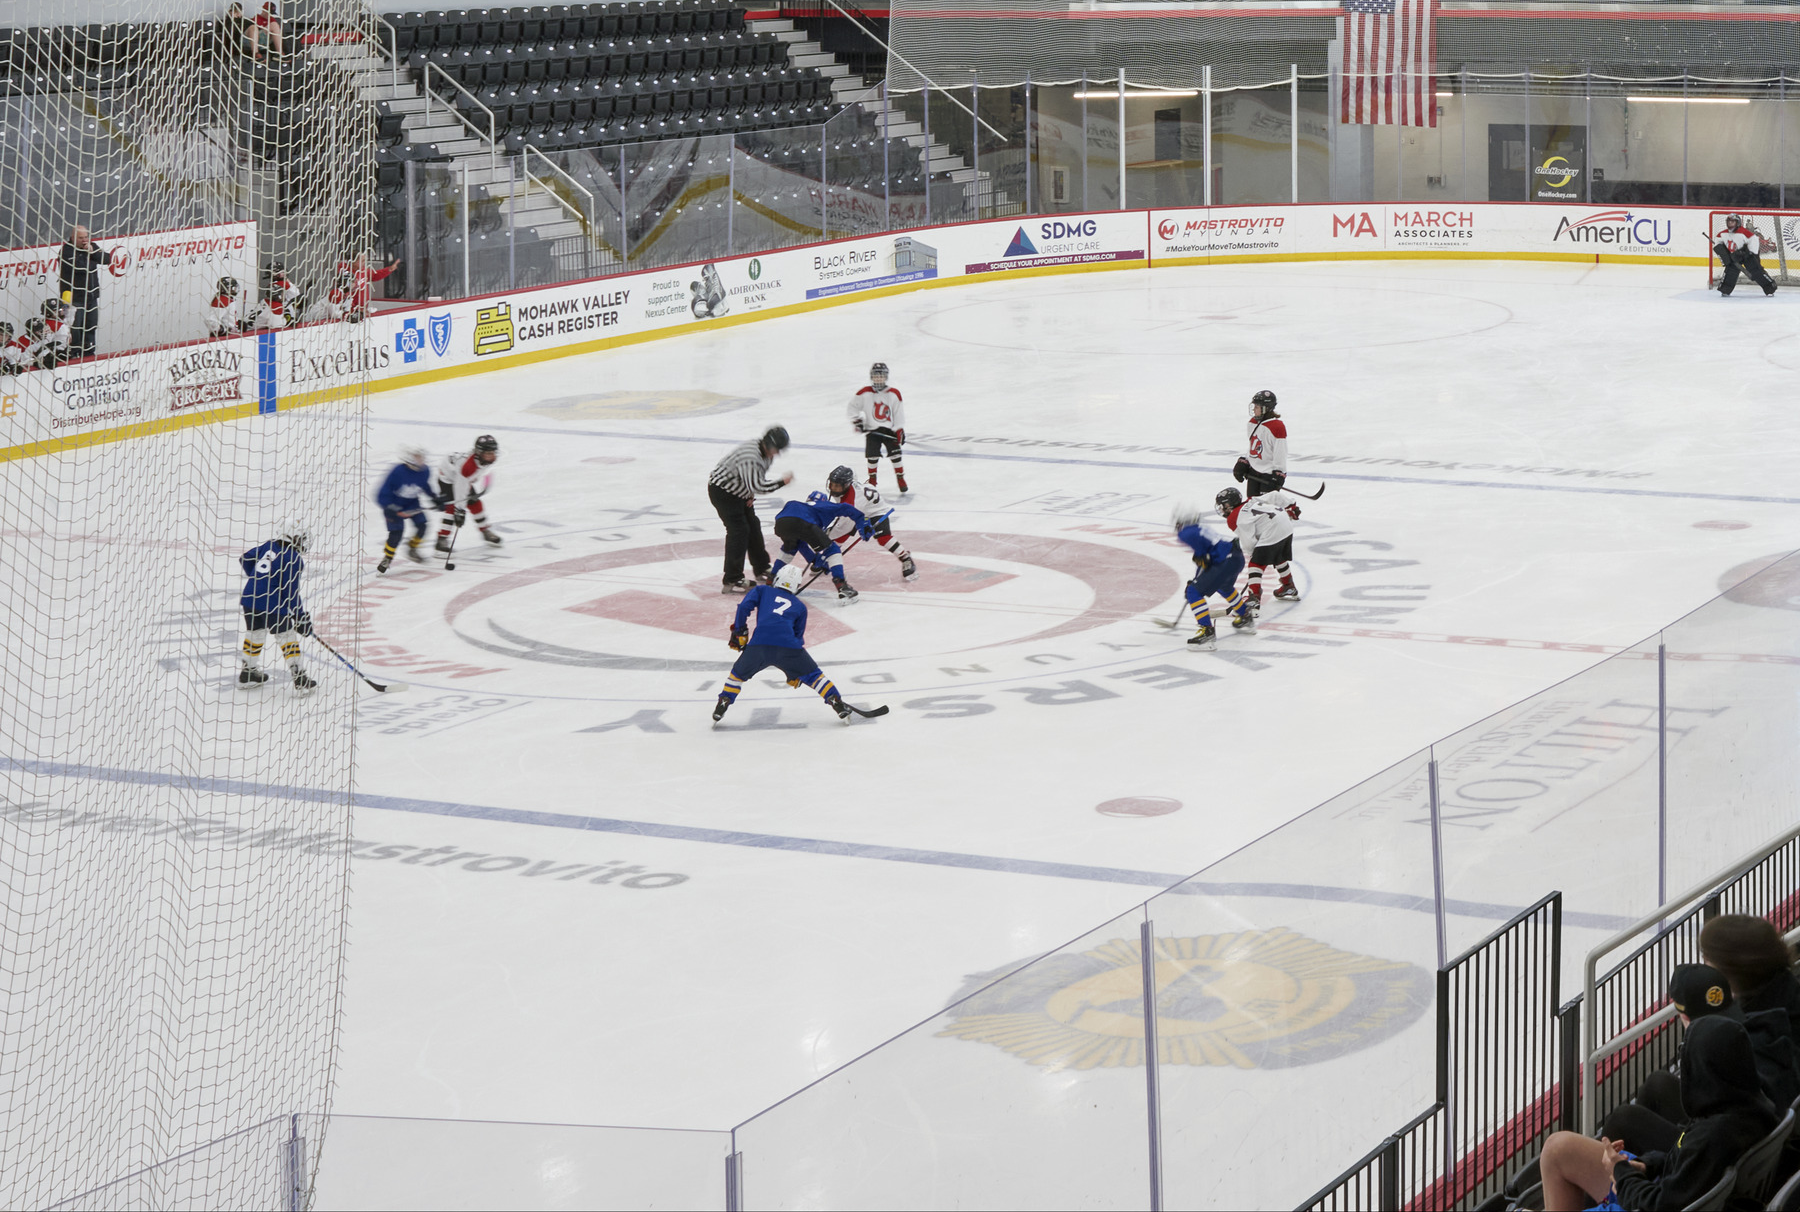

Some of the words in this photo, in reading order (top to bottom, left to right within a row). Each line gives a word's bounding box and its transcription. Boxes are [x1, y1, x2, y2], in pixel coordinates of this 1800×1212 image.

[1534, 166, 1579, 177] OneHockey
[1538, 191, 1577, 199] OneHockey.com
[1041, 219, 1097, 240] SDMG
[1185, 217, 1285, 230] MASTROVITO
[1333, 212, 1378, 238] MA
[1394, 211, 1473, 227] MARCH
[1182, 228, 1284, 238] HYUNDAI
[1394, 230, 1473, 238] ASSOCIATES
[1553, 216, 1671, 246] AmeriCU
[138, 235, 245, 262] MASTROVITO
[1040, 243, 1074, 254] URGENT
[1077, 241, 1100, 251] CARE
[1165, 241, 1279, 253] #MakeYourMoveToMastrovito
[990, 261, 1017, 270] SCHEDULE
[1017, 260, 1033, 268] YOUR
[1034, 256, 1073, 266] APPOINTMENT
[1082, 252, 1116, 262] SDMG.COM
[652, 281, 671, 292] Proud
[672, 280, 680, 288] to
[728, 279, 782, 297] ADIRONDACK
[518, 298, 579, 322] MOHAWK
[582, 290, 631, 310] VALLEY
[647, 294, 673, 307] support
[674, 291, 685, 301] the
[743, 293, 767, 305] BANK
[645, 307, 666, 319] Nexus
[666, 303, 688, 315] Center
[518, 323, 553, 341] CASH
[557, 311, 619, 335] REGISTER
[167, 349, 243, 385] BARGAIN
[289, 339, 391, 385] Excellus
[52, 368, 141, 395] Compassion
[66, 387, 131, 411] Coalition
[173, 378, 240, 407] GROCERY
[52, 405, 142, 430] DistributeHope.org
[255, 550, 278, 573] 6
[773, 595, 792, 616] 7
[1403, 698, 1731, 831] HILTON
